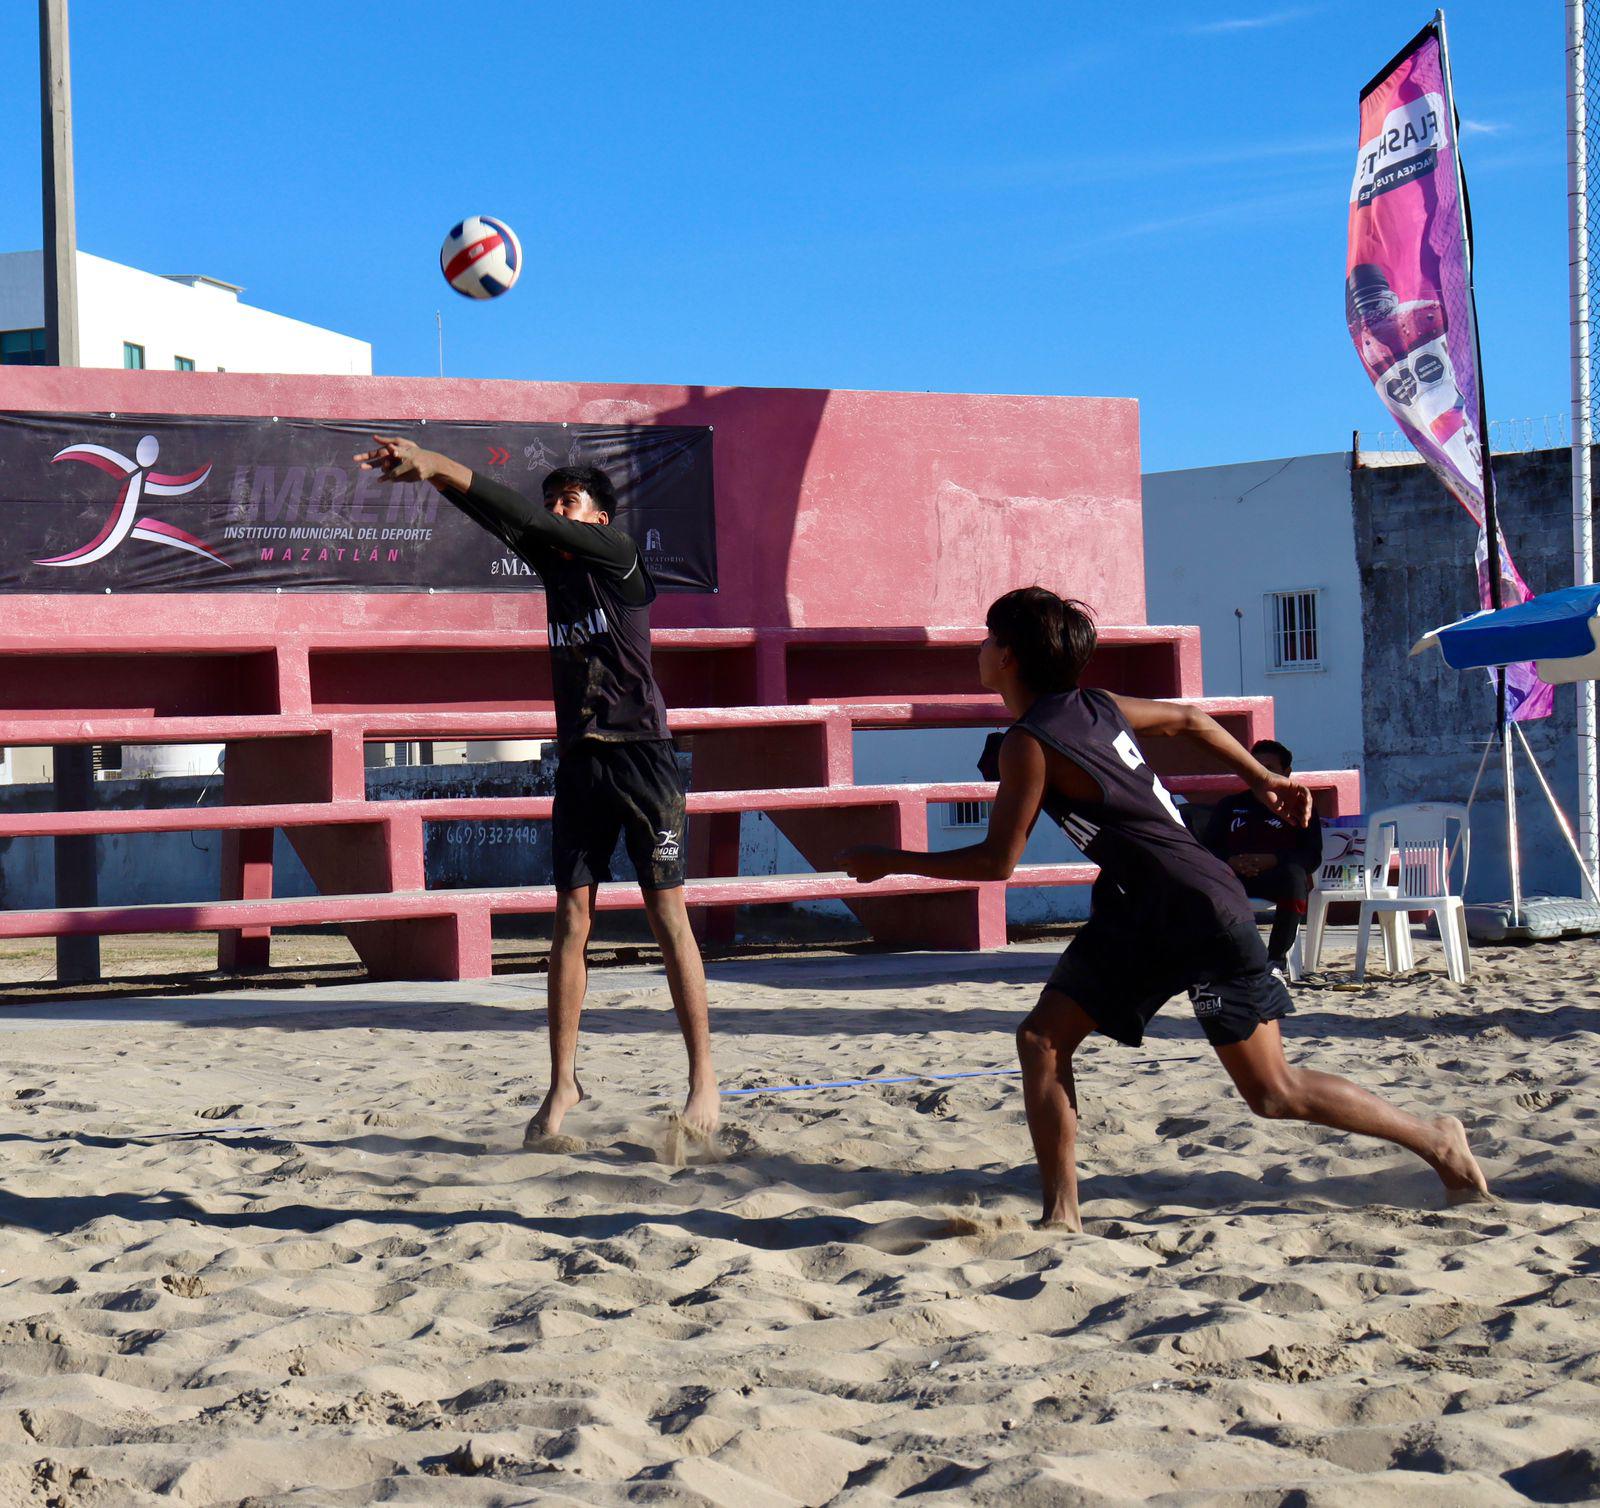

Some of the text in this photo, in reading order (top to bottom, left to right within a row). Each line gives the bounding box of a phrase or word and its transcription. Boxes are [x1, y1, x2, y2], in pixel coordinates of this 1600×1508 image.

[226, 464, 441, 524] IMDEM
[223, 526, 433, 542] INSTITUTO MUNICIPAL DEL DEPORTE
[260, 546, 400, 562] MAZATLÁN
[501, 558, 537, 576] MA
